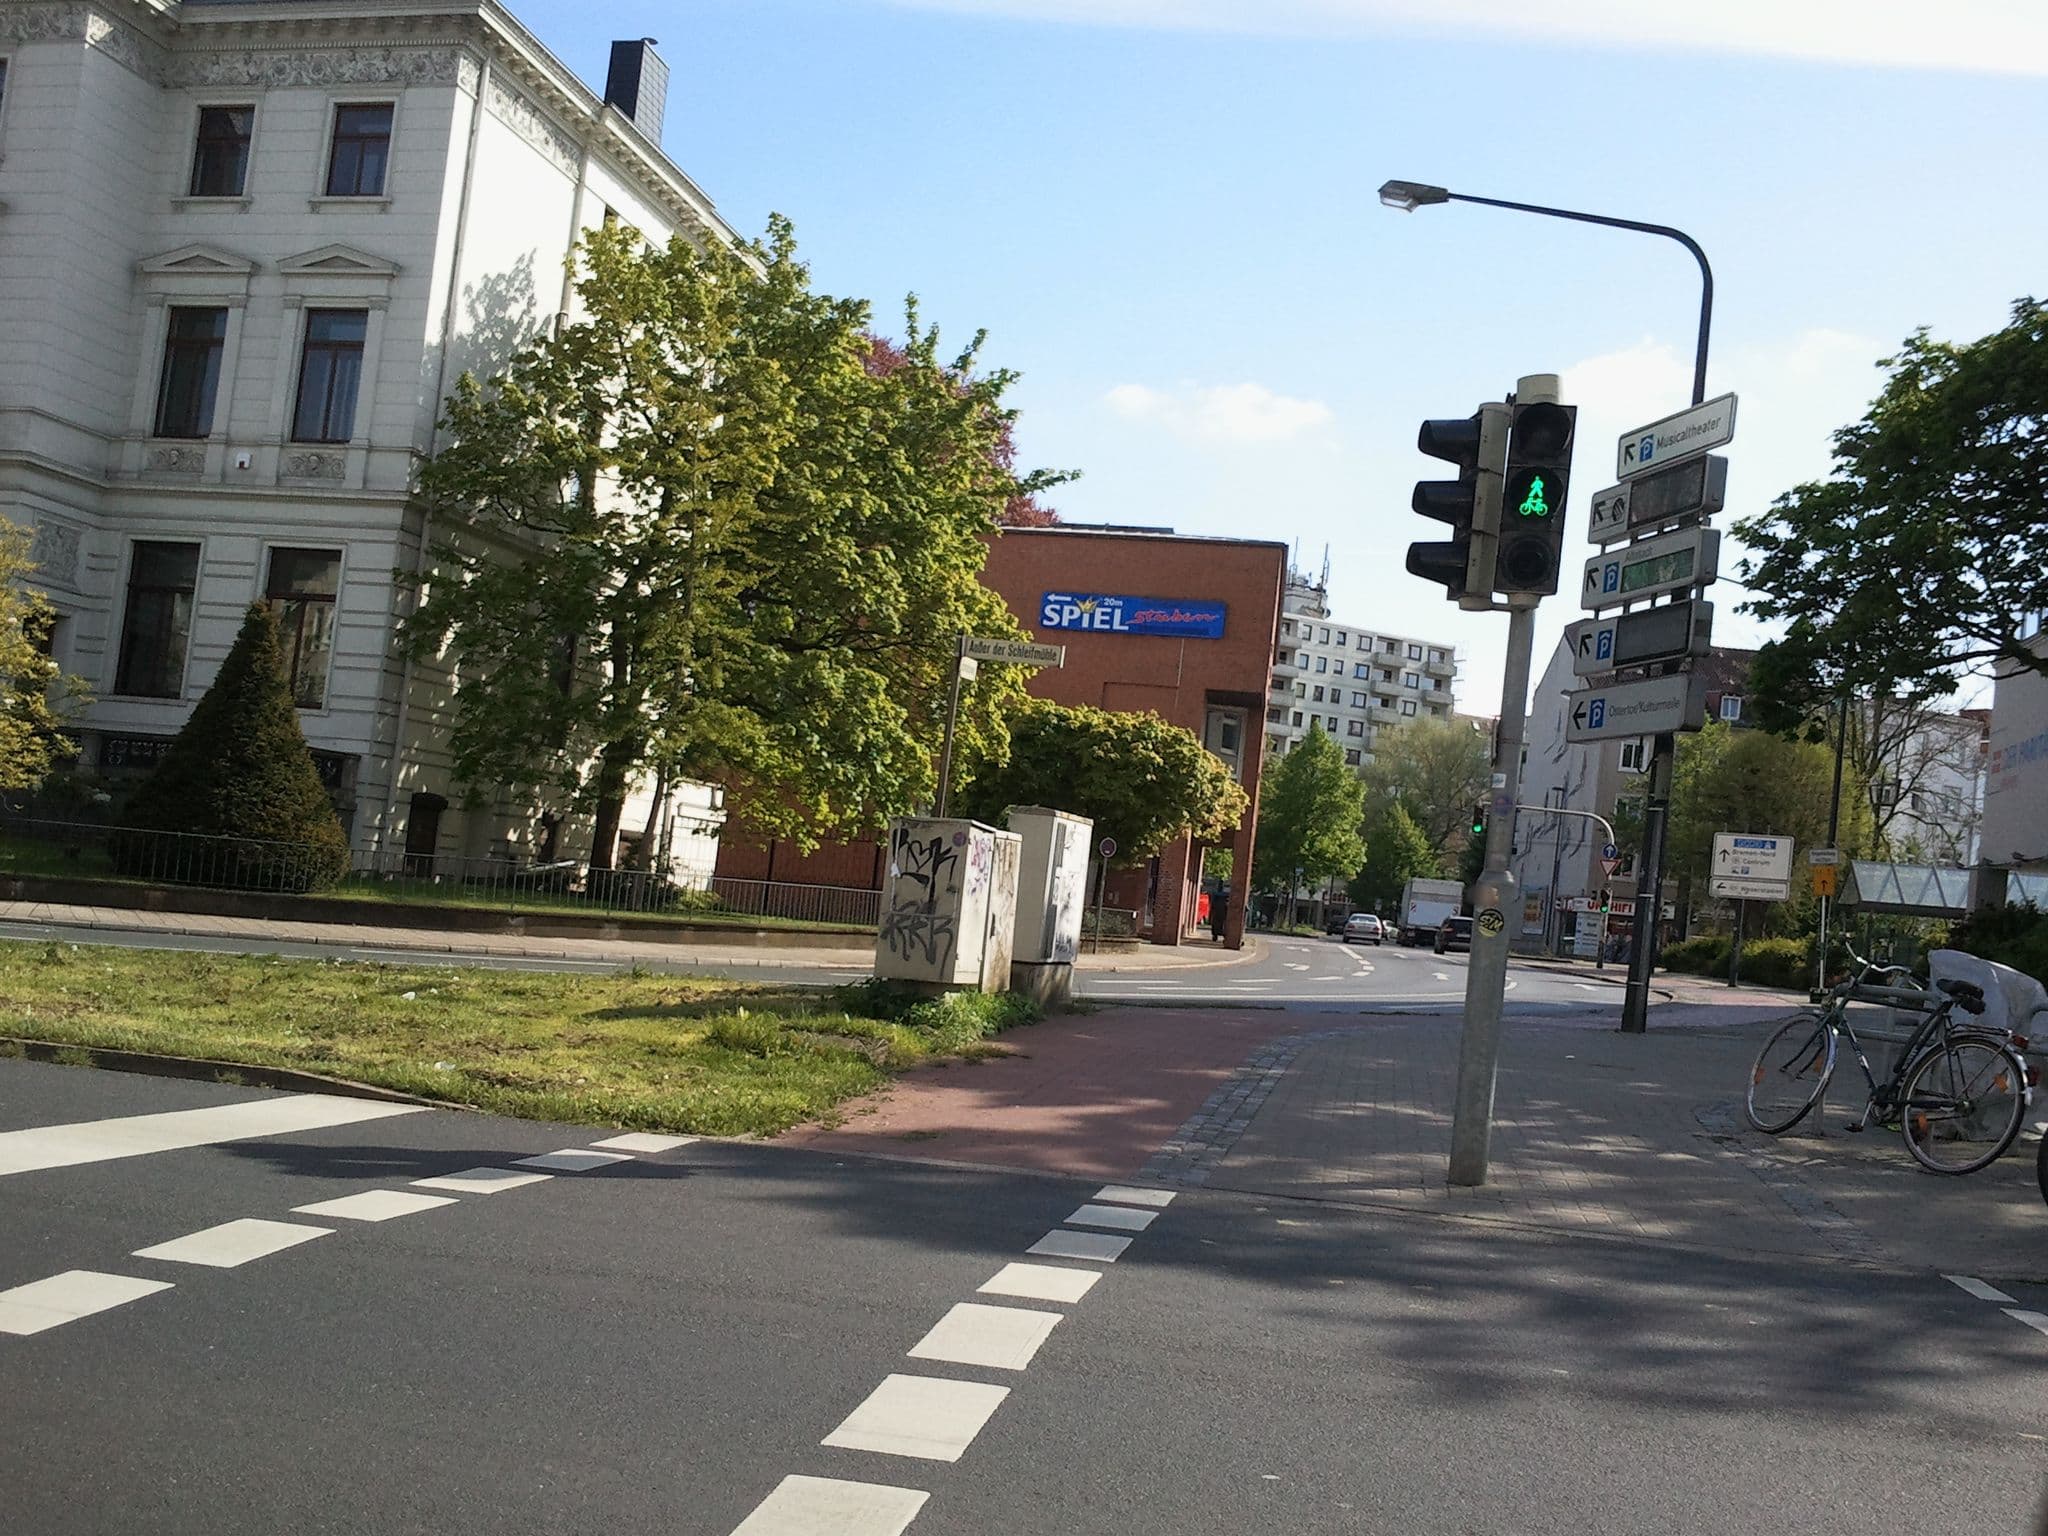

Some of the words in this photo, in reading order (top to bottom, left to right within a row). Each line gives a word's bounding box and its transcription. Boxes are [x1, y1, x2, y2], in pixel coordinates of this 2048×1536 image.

[1656, 416, 1722, 449] Musicaltheater
[1103, 598, 1124, 607] 20m
[968, 639, 991, 655] Außer
[993, 642, 1006, 657] der
[1008, 644, 1057, 662] Schleifmühle
